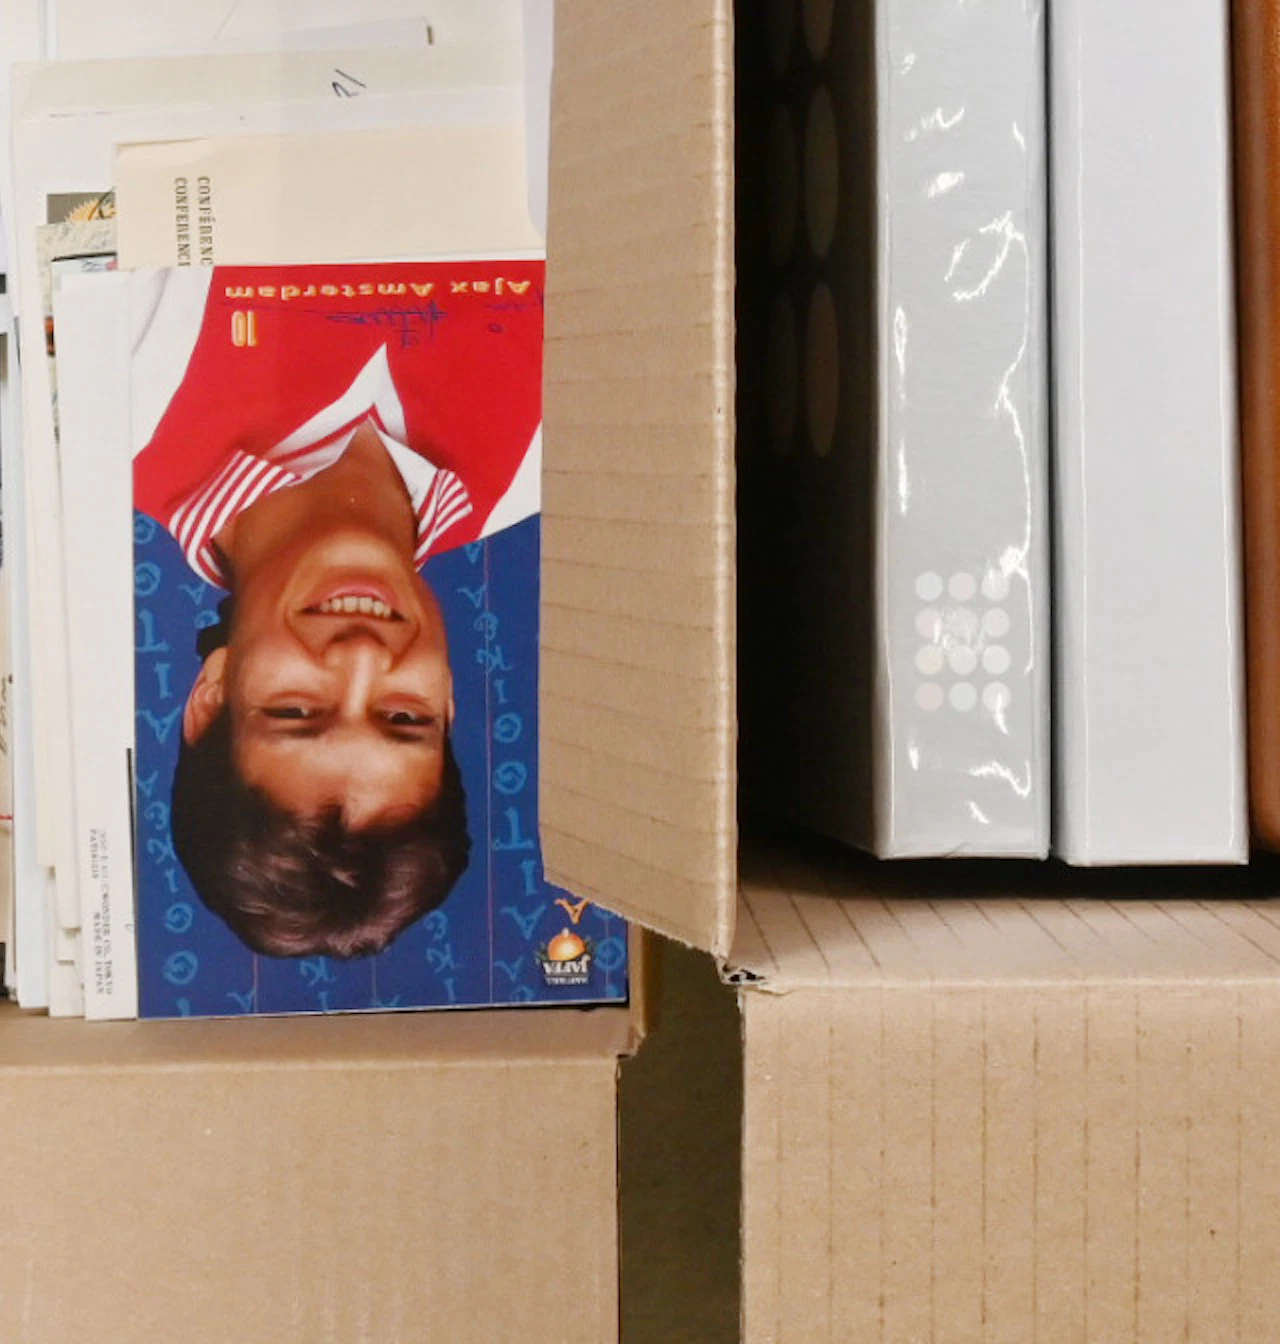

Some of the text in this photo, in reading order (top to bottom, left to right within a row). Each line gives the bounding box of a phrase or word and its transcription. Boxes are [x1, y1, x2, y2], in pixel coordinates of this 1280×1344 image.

[225, 276, 531, 302] Ajax Amsterdam
[231, 310, 258, 348] 10
[95, 959, 104, 994] JAPAN
